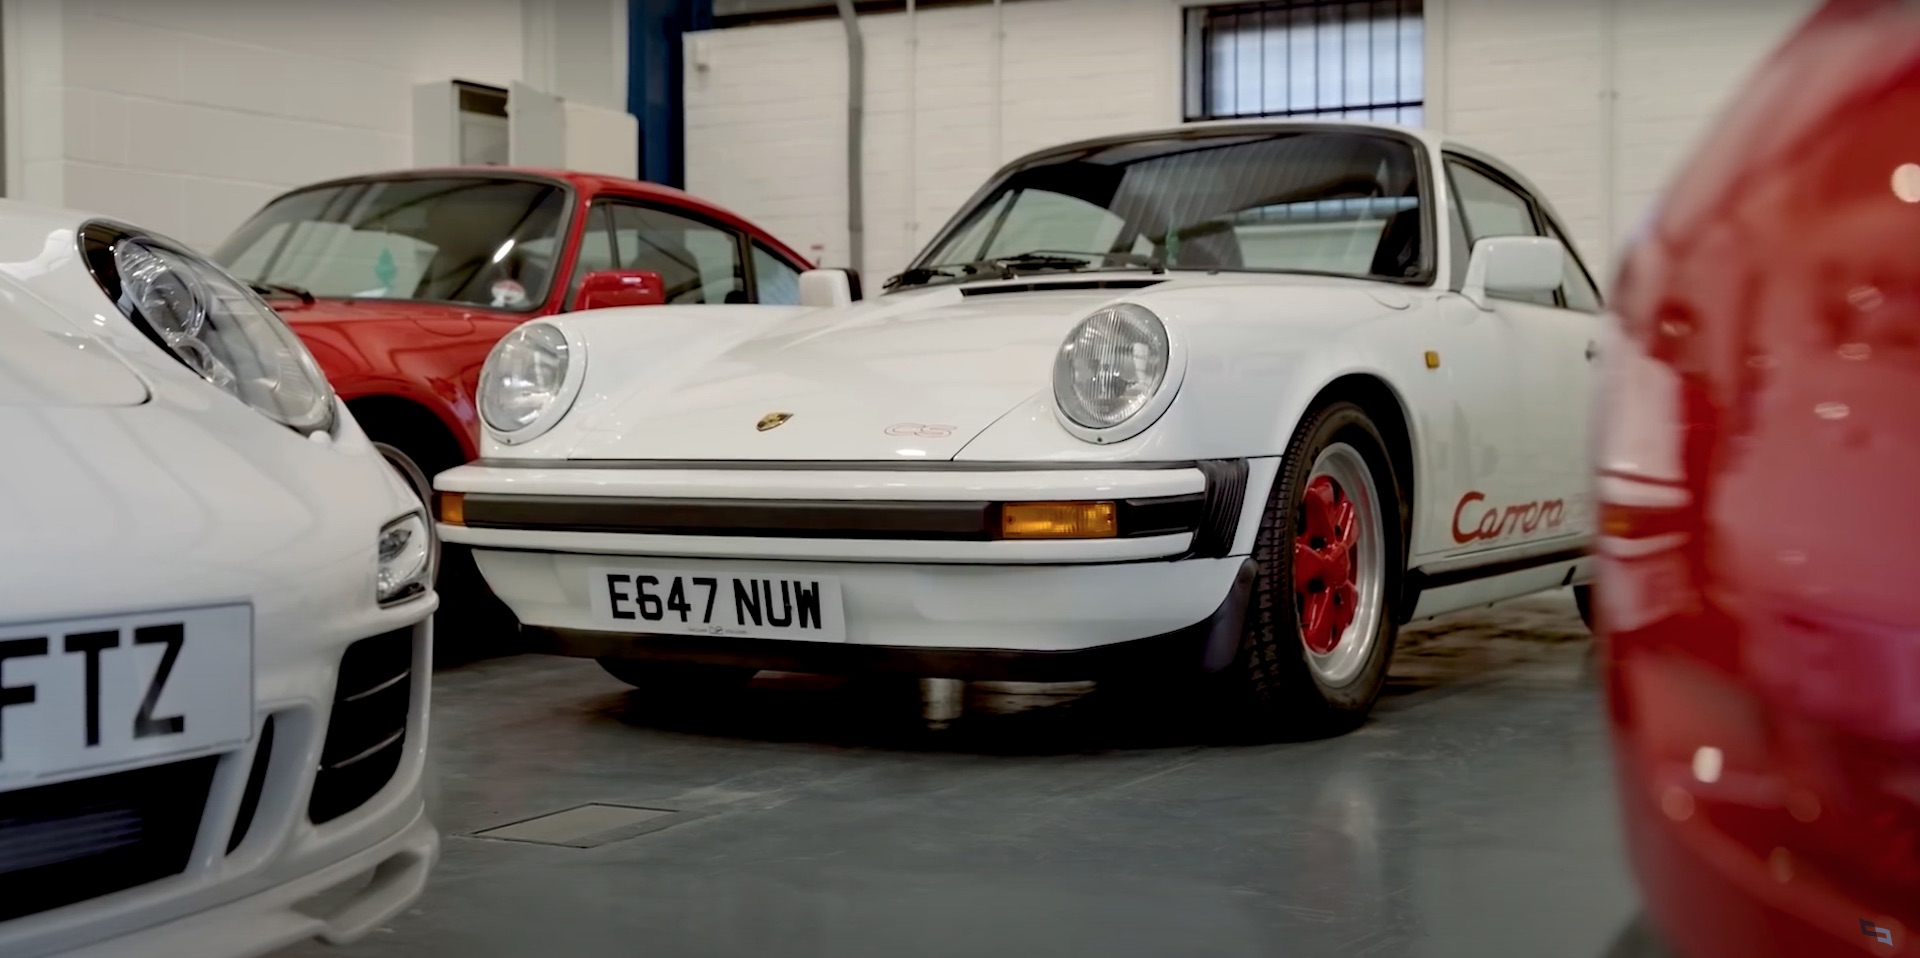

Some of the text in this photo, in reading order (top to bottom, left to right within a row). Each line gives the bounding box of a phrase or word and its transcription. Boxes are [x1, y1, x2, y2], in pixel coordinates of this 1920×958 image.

[884, 422, 957, 438] CS
[1452, 491, 1564, 544] Carrera
[606, 574, 822, 629] E647 NUW
[0, 622, 185, 762] FTZ
